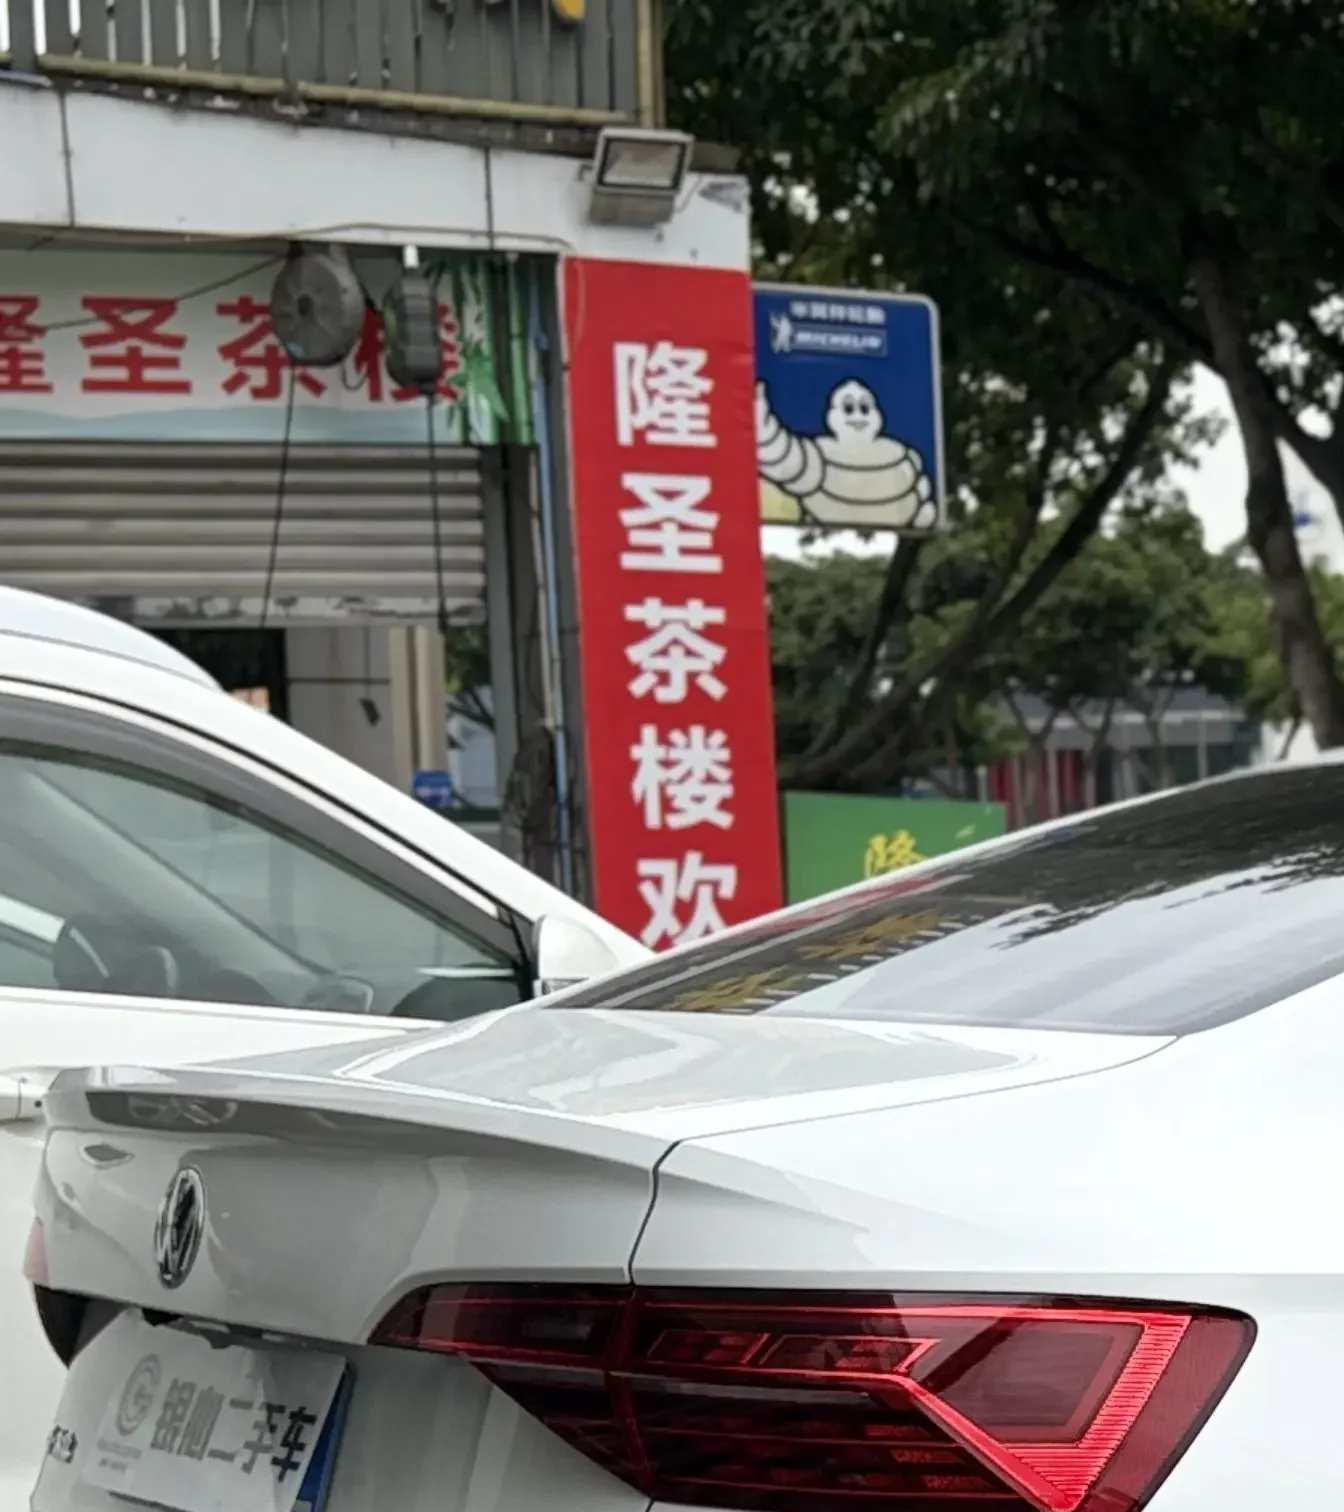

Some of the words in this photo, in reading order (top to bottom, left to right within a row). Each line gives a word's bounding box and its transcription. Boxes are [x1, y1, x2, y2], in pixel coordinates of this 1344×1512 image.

[613, 340, 738, 949] 隆圣茶楼欢
